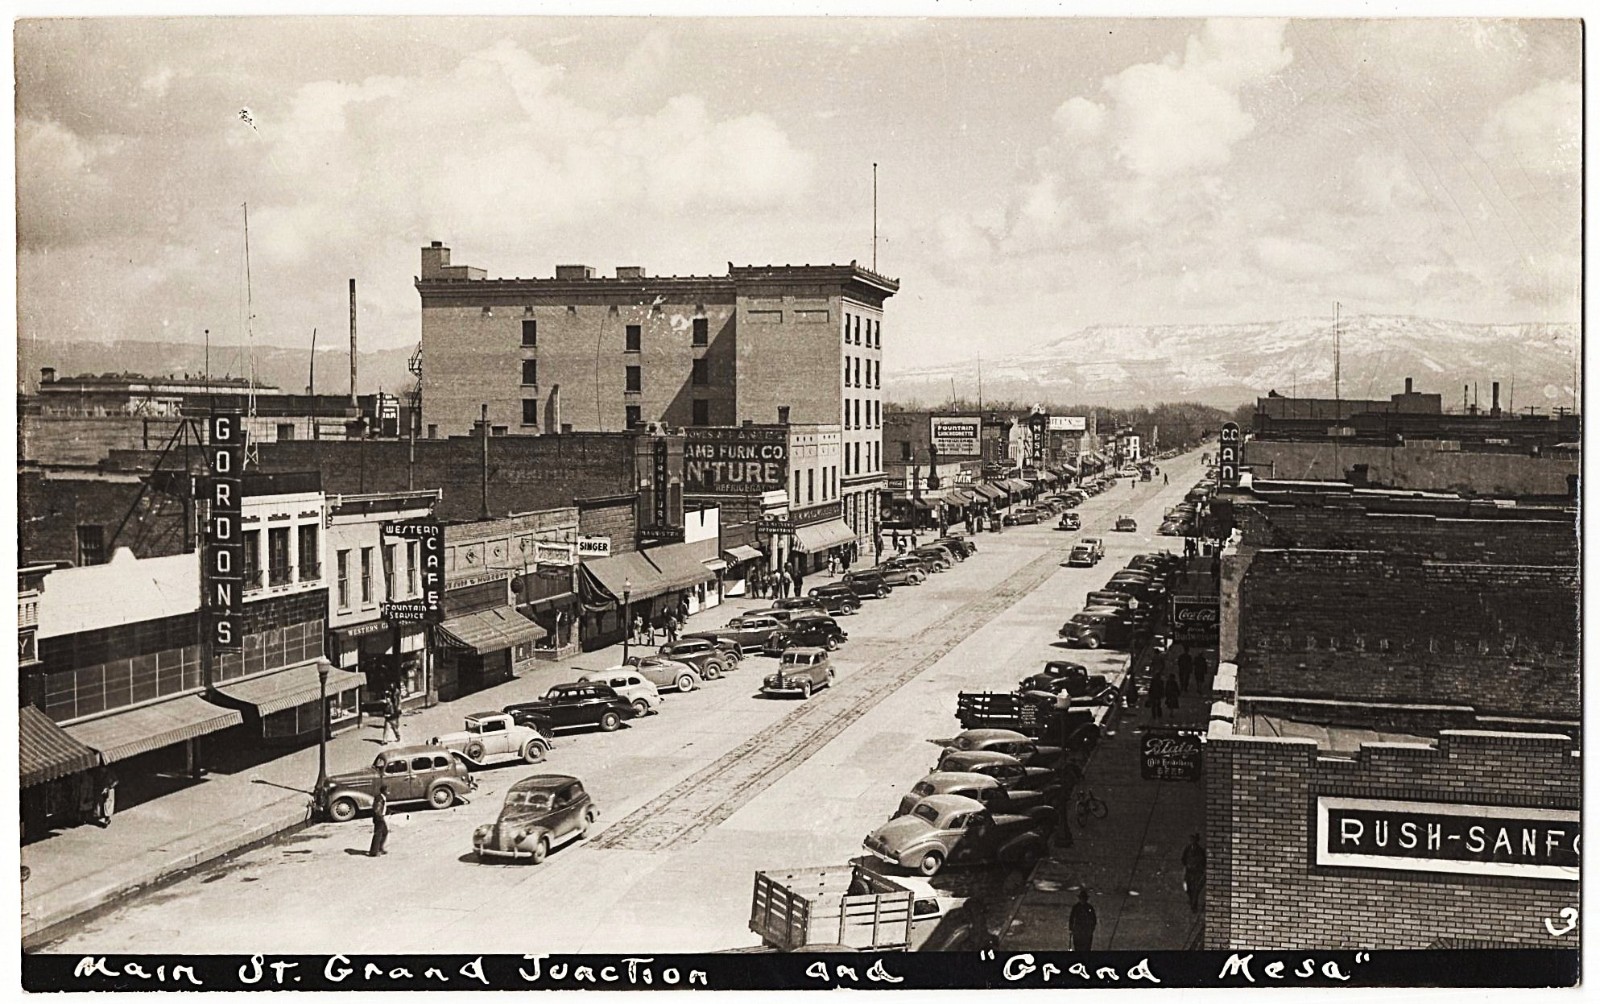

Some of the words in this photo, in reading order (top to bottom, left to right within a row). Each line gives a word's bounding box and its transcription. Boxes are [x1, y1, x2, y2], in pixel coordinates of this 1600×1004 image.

[1033, 424, 1042, 458] MESA
[761, 445, 787, 460] CO.
[215, 417, 231, 643] GORDON'S
[385, 525, 439, 536] WESTERN
[579, 541, 609, 552] SINGER
[426, 537, 439, 605] CAFE
[384, 604, 427, 616] FOUNTAIN
[389, 611, 424, 620] SERVICE
[347, 624, 379, 637] WESTERN
